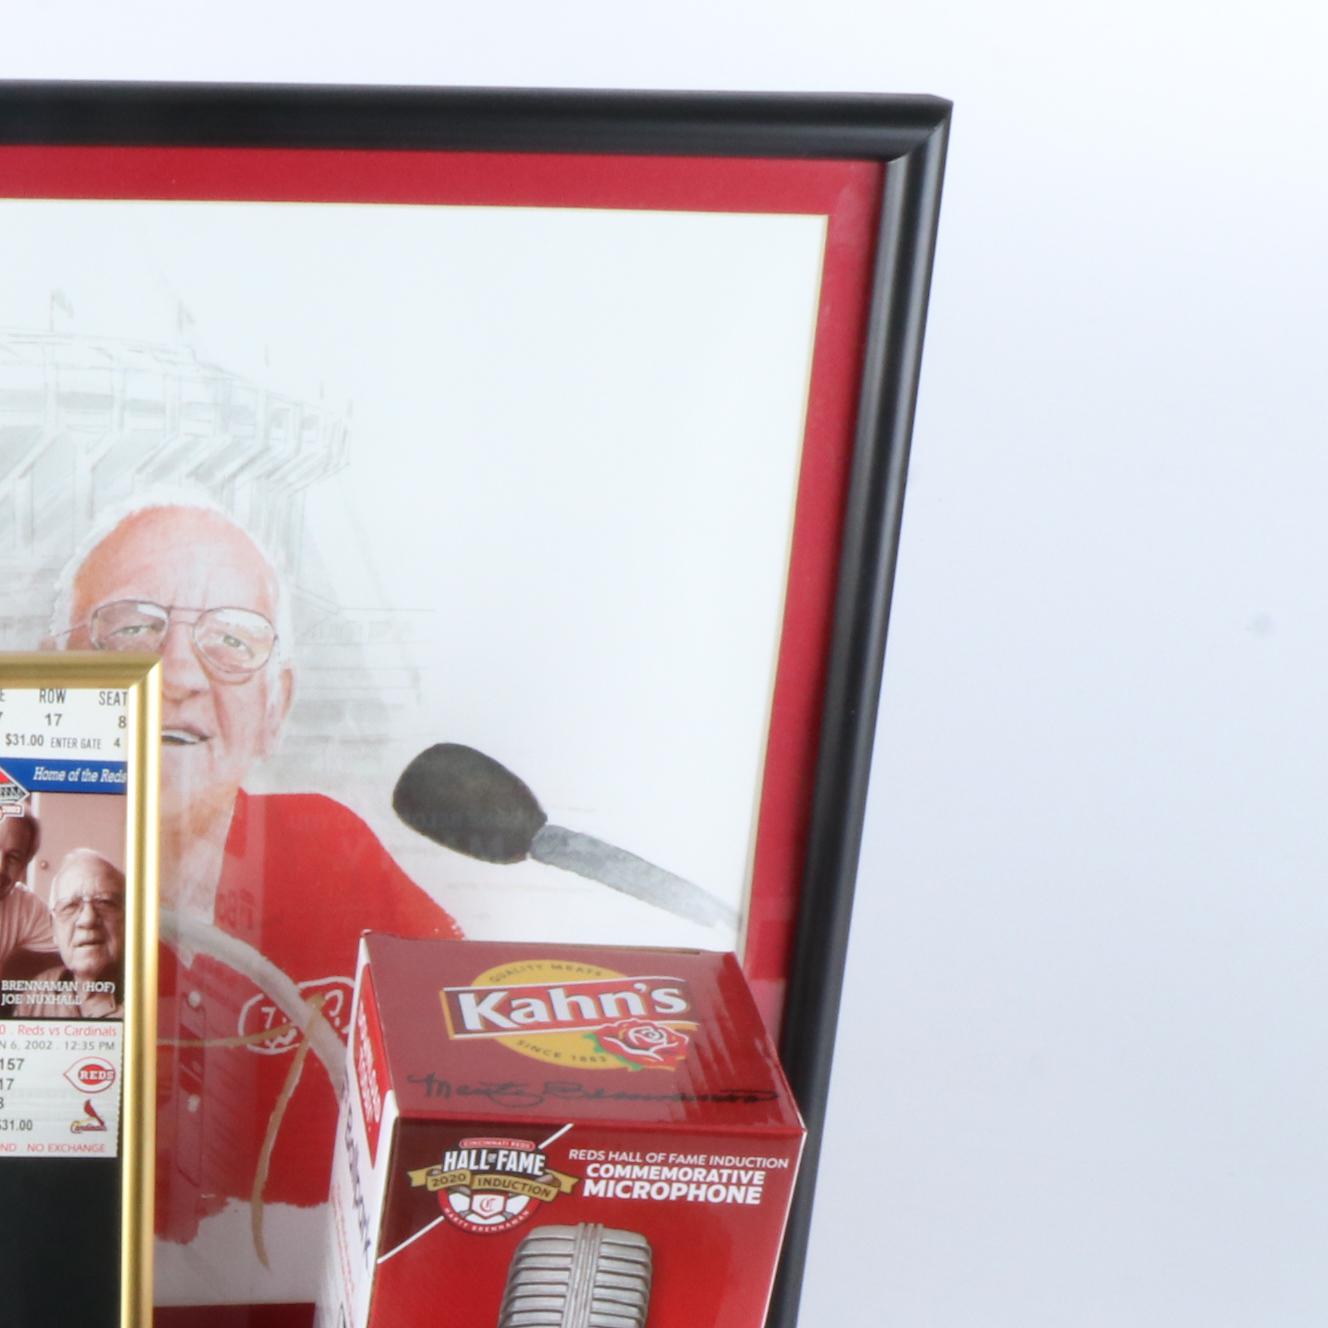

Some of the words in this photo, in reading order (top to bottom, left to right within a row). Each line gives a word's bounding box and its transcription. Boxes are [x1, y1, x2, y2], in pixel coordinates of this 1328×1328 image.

[39, 689, 66, 704] ROW
[99, 691, 127, 706] SEAT
[45, 713, 62, 726] 17
[118, 716, 127, 729] 8
[5, 734, 44, 747] $31.00
[51, 737, 78, 749] ENTER
[81, 738, 101, 750] GATE
[114, 740, 121, 748] 4
[33, 766, 65, 781] Home
[68, 767, 79, 782] of
[81, 768, 98, 782] the
[489, 963, 543, 983] QUALITY
[550, 962, 603, 977] MEATS
[1, 980, 78, 992] BRENNAMAN
[81, 981, 115, 993] (HOF)
[1, 995, 22, 1006] JOE
[26, 994, 83, 1005] NUXHALL
[458, 982, 688, 1031] Kahn's
[17, 1024, 45, 1036] Reds
[49, 1026, 60, 1035] vs
[64, 1024, 116, 1037] Cardinals
[25, 1040, 53, 1050] 2002
[64, 1040, 95, 1050] 12:35
[99, 1040, 115, 1050] PM
[516, 1038, 562, 1060] SINCE
[77, 1069, 114, 1081] REDS
[27, 1143, 44, 1153] NO
[47, 1143, 105, 1153] EXCHANGE
[443, 1150, 489, 1172] HALL
[496, 1151, 546, 1175] FAME
[569, 1149, 605, 1160] REDS
[608, 1151, 642, 1162] HALL
[645, 1152, 666, 1164] OF
[669, 1153, 705, 1165] FAME
[709, 1155, 789, 1169] INDUCTION
[586, 1162, 766, 1185] COMMEMORATIVE
[431, 1172, 467, 1188] 2020
[477, 1174, 552, 1199] INDUCTION
[583, 1178, 763, 1205] MICROPHONE
